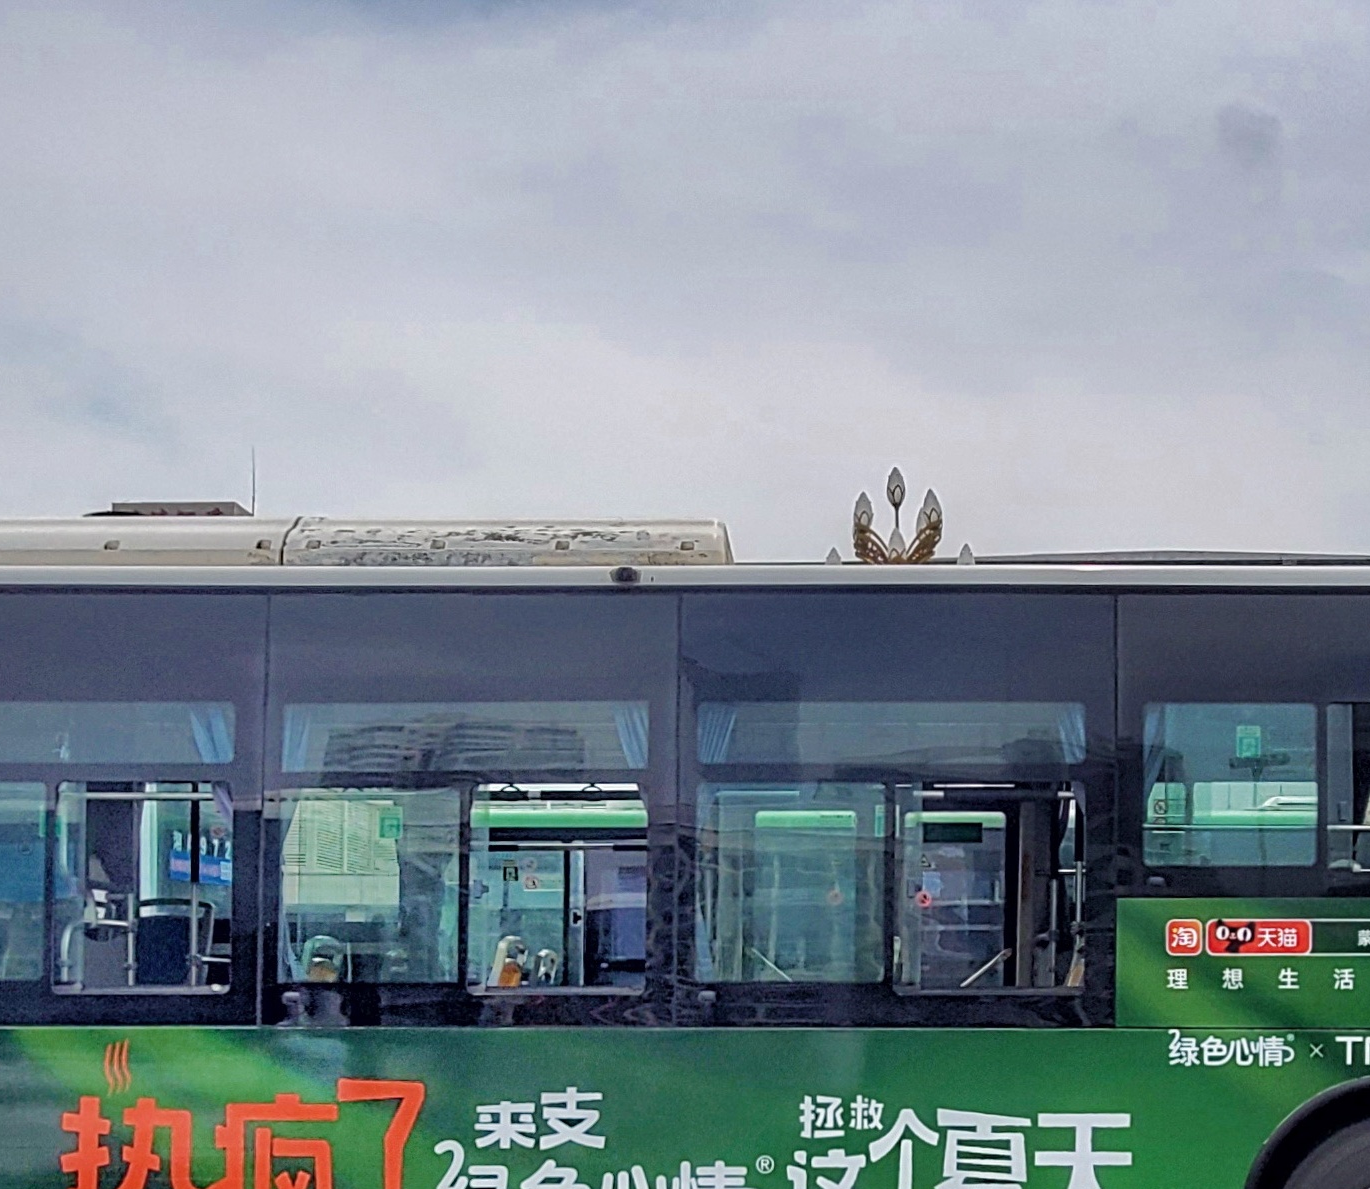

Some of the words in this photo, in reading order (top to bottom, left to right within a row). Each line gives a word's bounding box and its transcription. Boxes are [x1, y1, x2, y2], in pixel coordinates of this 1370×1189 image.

[1171, 926, 1199, 949] 淘
[1256, 927, 1299, 949] 天猫
[1167, 1029, 1296, 1068] 绿色心情
[475, 1087, 606, 1152] 来支
[799, 1094, 884, 1139] 拯救
